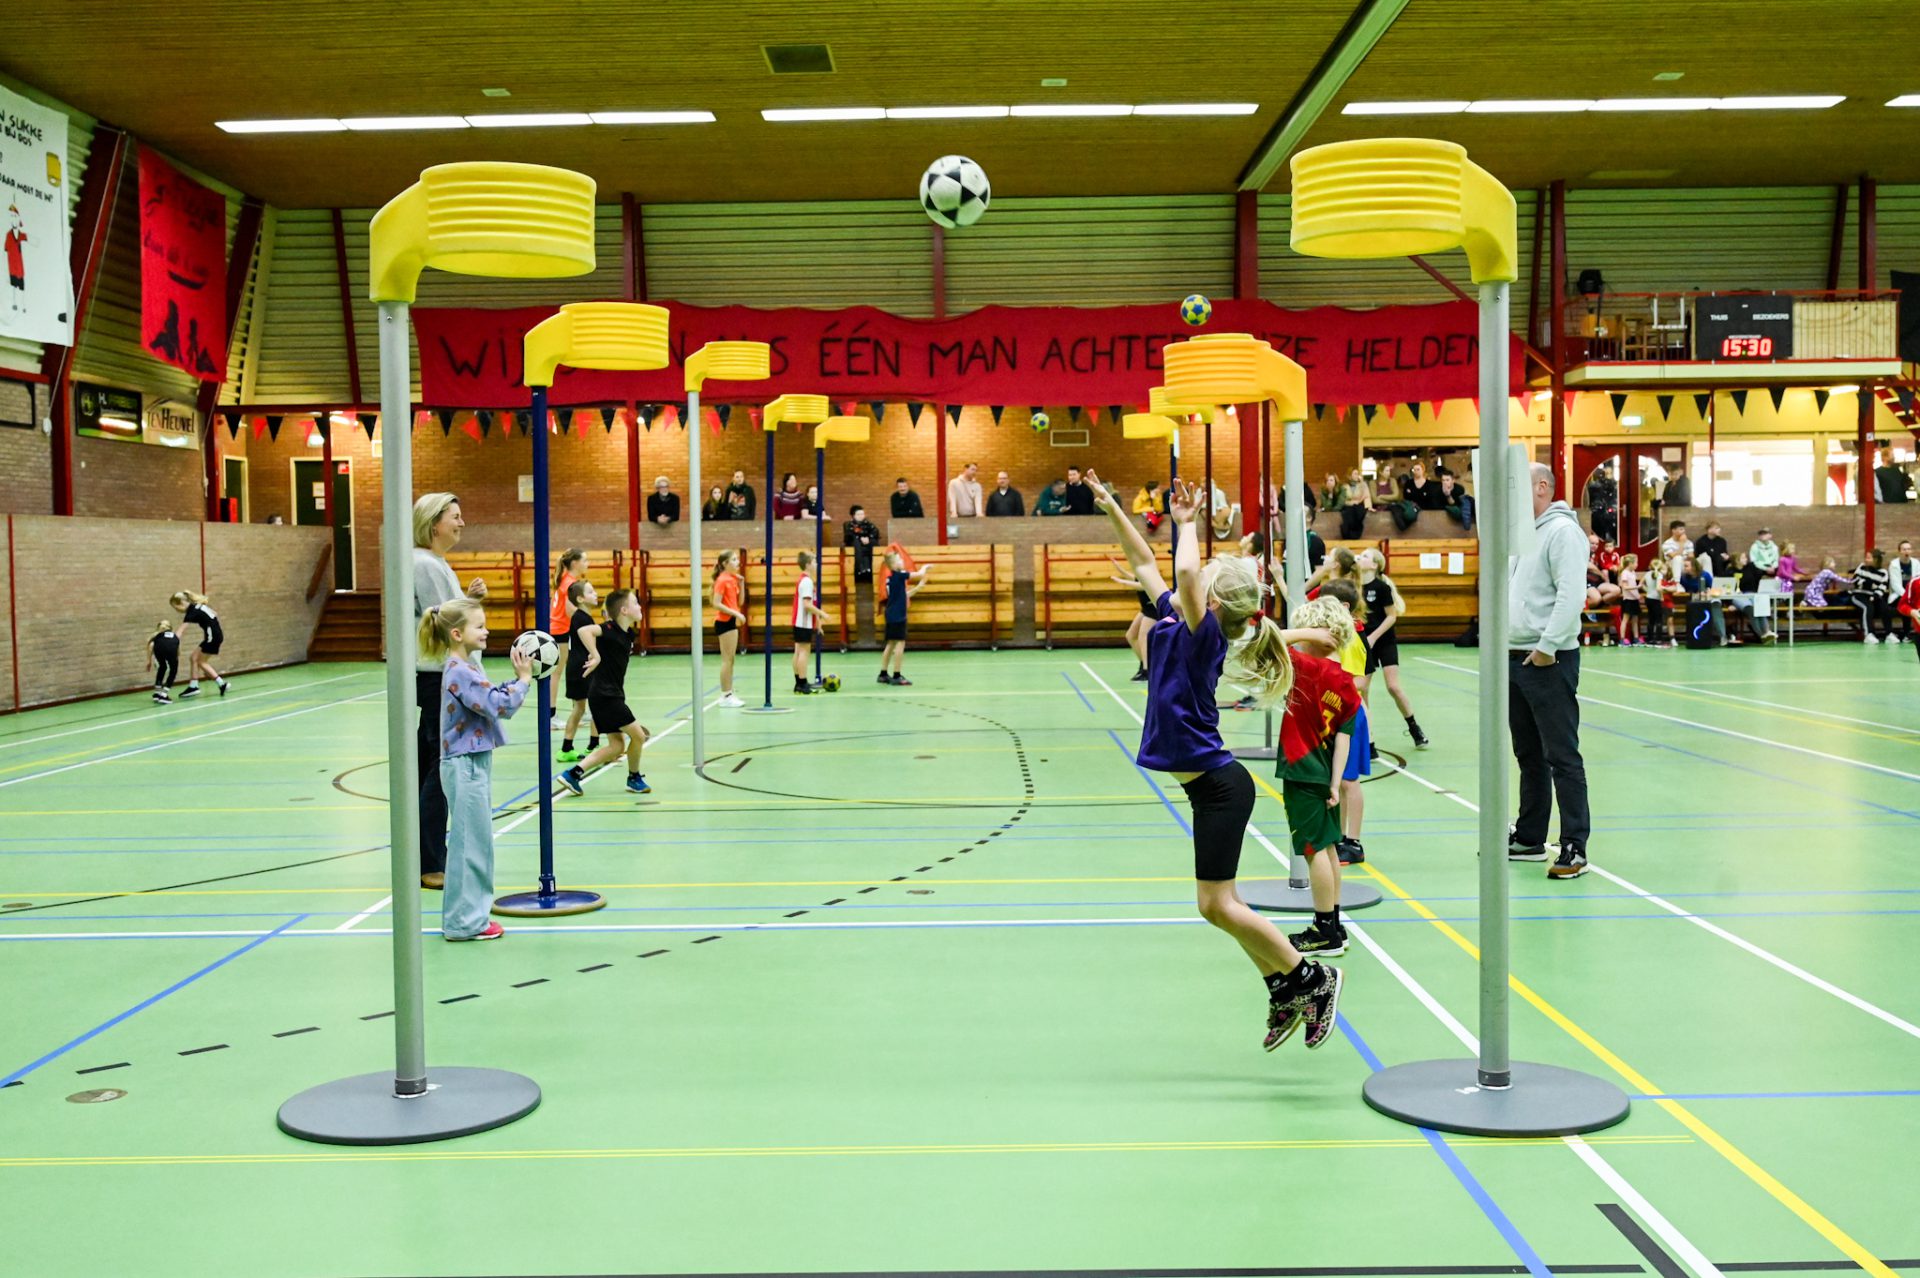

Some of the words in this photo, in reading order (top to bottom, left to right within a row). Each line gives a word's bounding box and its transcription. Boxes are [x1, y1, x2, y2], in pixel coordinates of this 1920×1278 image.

[9, 114, 42, 142] SUKKE
[819, 320, 900, 378] ÉÉN
[928, 336, 1018, 378] MAN
[1040, 333, 1193, 374] ACHTE
[1722, 338, 1772, 357] 15:30
